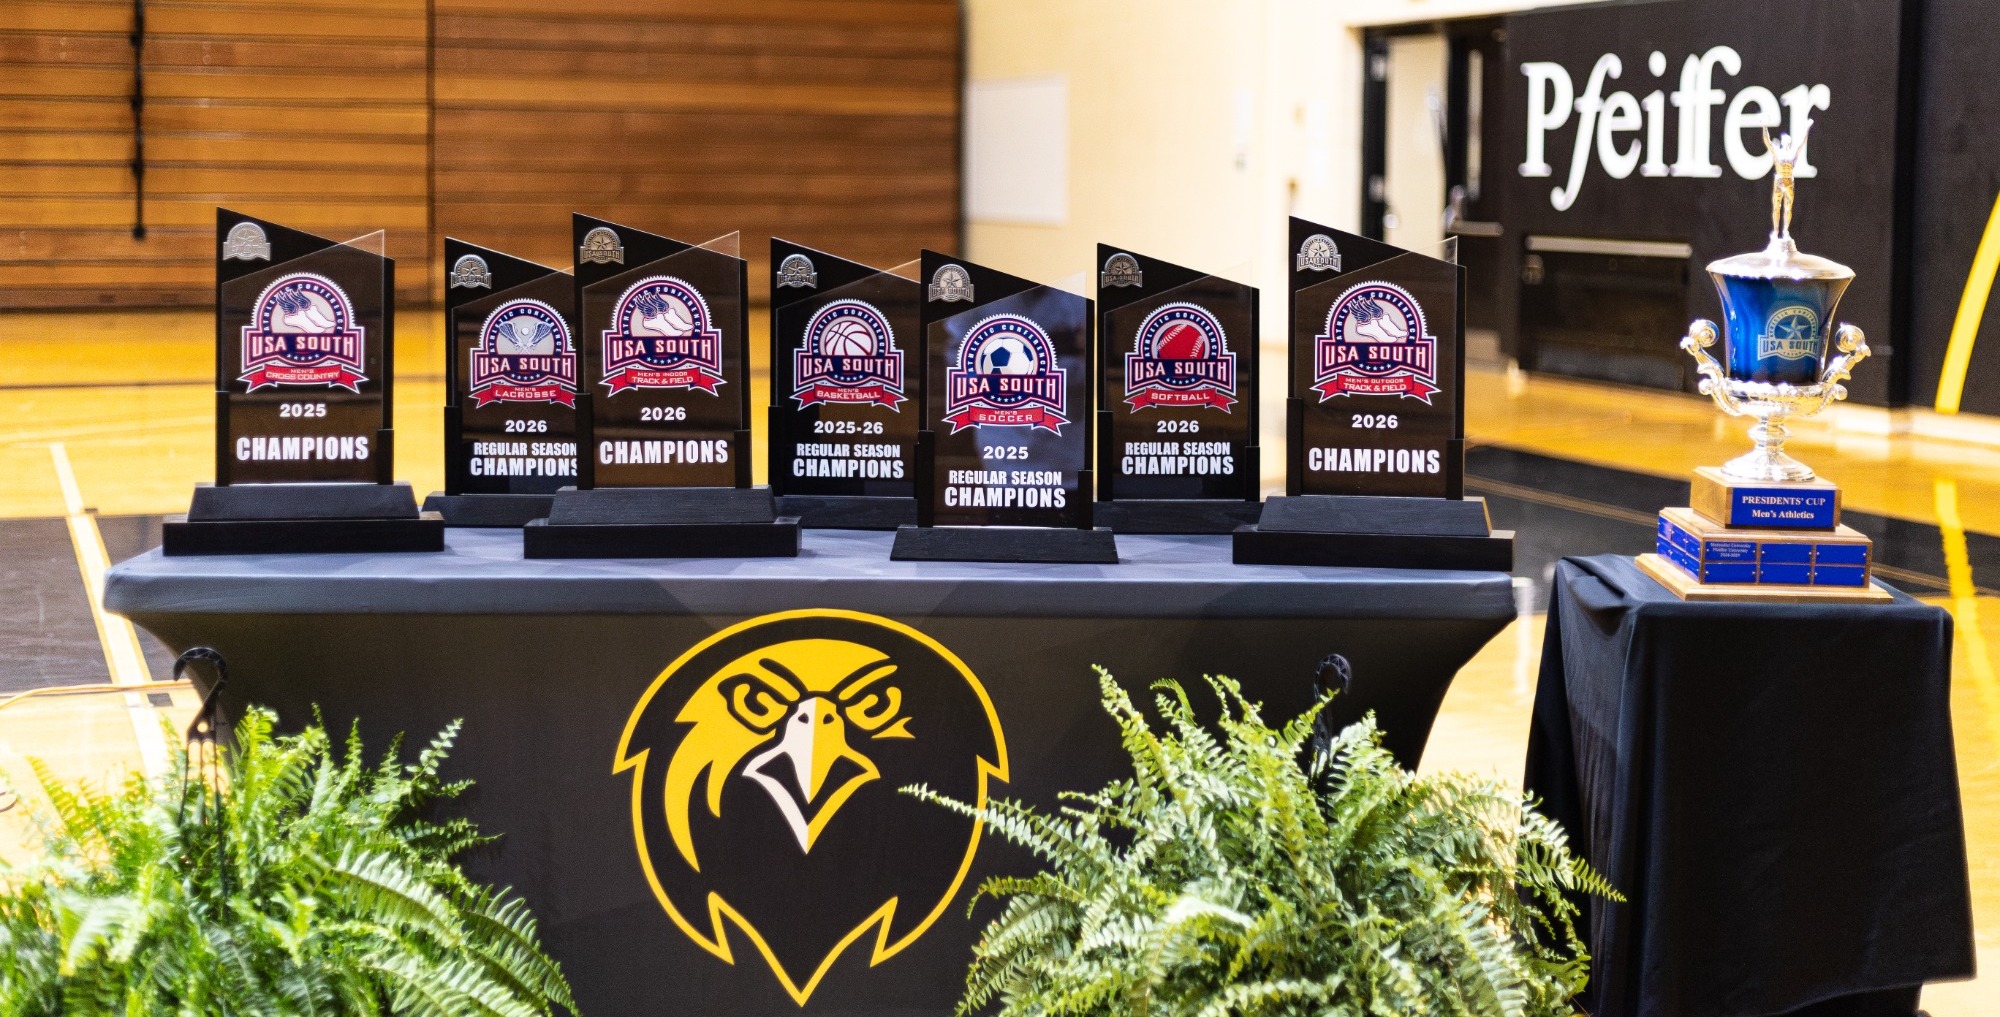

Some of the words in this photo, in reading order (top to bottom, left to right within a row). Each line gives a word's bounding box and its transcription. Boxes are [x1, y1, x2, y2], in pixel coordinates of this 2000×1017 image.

[1518, 45, 1830, 211] Pfeiffer
[298, 284, 343, 330] CONFERENCE
[656, 286, 701, 333] CONFERENCE
[1370, 292, 1416, 340] CONFERENCE
[812, 311, 838, 354] ATHLETIC
[844, 308, 885, 353] CONFERENCE
[1144, 315, 1170, 357] ATHLETIC
[1176, 312, 1218, 356] CONFERENCE
[252, 336, 286, 358] USA
[296, 336, 354, 358] SOUTH
[613, 340, 646, 361] USA
[655, 340, 712, 360] SOUTH
[968, 328, 995, 372] ATHLETIC
[1001, 324, 1046, 372] CONFERENCE
[1763, 341, 1783, 352] USA
[1789, 340, 1818, 354] SOUTH
[1325, 346, 1358, 366] USA
[1368, 346, 1426, 369] SOUTH
[266, 371, 296, 380] CROSS
[298, 372, 340, 380] COUNTRY
[480, 358, 511, 377] USA
[520, 358, 571, 378] SOUTH
[803, 358, 834, 378] USA
[842, 358, 894, 379] SOUTH
[1134, 362, 1166, 382] USA
[1174, 362, 1226, 382] SOUTH
[632, 376, 660, 384] TRACK
[670, 376, 694, 384] FIELD
[956, 377, 990, 399] USA
[1000, 378, 1056, 400] SOUTH
[495, 390, 556, 398] LACROSSE
[816, 390, 880, 400] BASKETBALL
[280, 404, 326, 418] 2025
[640, 406, 686, 421] 2026
[978, 414, 1033, 422] SOCCER
[505, 420, 548, 433] 2026
[814, 420, 884, 434] 2025-26
[1156, 420, 1200, 433] 2026
[1352, 414, 1398, 429] 2026
[236, 436, 369, 461] CHAMPIONS
[473, 442, 528, 456] REGULAR
[532, 442, 576, 456] SEASON
[600, 440, 729, 464] CHAMPIONS
[796, 443, 850, 456] REGULAR
[854, 444, 900, 458] SEASON
[983, 446, 1029, 460] 2025
[1125, 442, 1180, 455] REGULAR
[1183, 442, 1231, 456] SEASON
[793, 458, 904, 479] CHAMPIONS
[1122, 456, 1234, 475] CHAMPIONS
[1308, 447, 1440, 474] CHAMPIONS
[949, 470, 1007, 485] REGULAR
[1011, 471, 1062, 486] SEASON
[944, 486, 1066, 508] CHAMPIONS
[1742, 496, 1804, 506] PRESIDENTS'
[1806, 498, 1826, 506] CUP
[1752, 509, 1777, 518] Men's
[1778, 510, 1815, 519] Athletics
